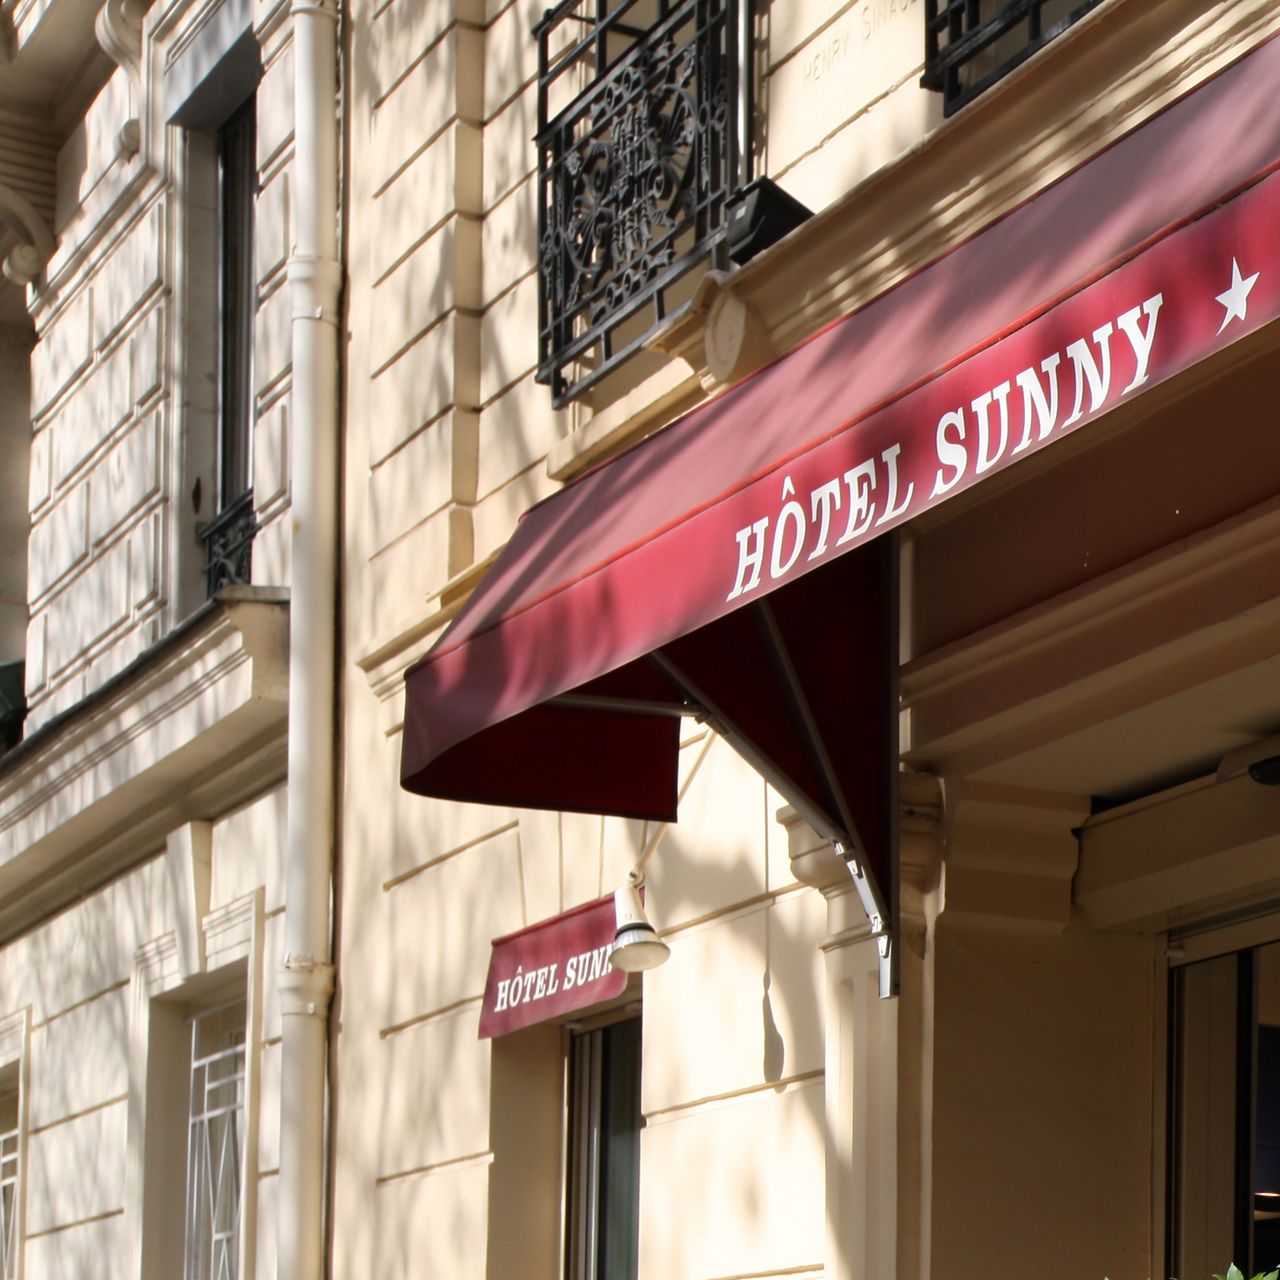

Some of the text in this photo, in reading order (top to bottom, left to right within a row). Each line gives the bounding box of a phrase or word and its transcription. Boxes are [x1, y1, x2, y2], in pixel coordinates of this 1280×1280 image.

[726, 292, 1164, 602] HÔTEL SUNNY
[494, 963, 559, 1013] HÔTEL
